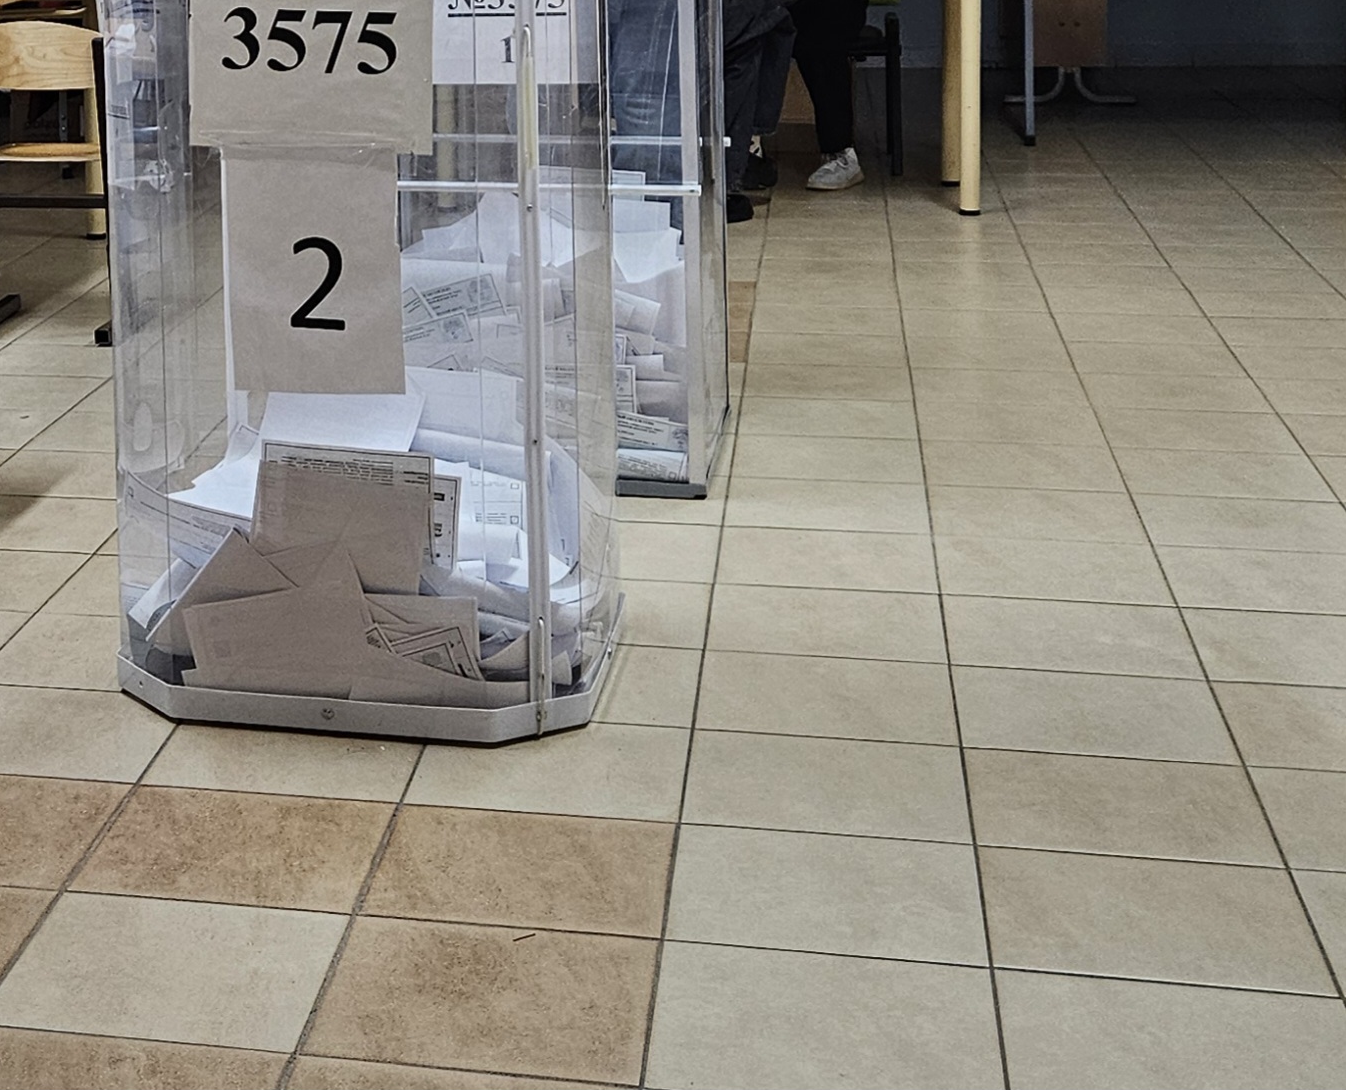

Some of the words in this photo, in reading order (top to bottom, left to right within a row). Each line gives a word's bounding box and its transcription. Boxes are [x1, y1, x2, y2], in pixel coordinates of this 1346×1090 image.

[221, 6, 398, 75] 3575
[500, 36, 515, 64] 1
[290, 236, 346, 331] 2
